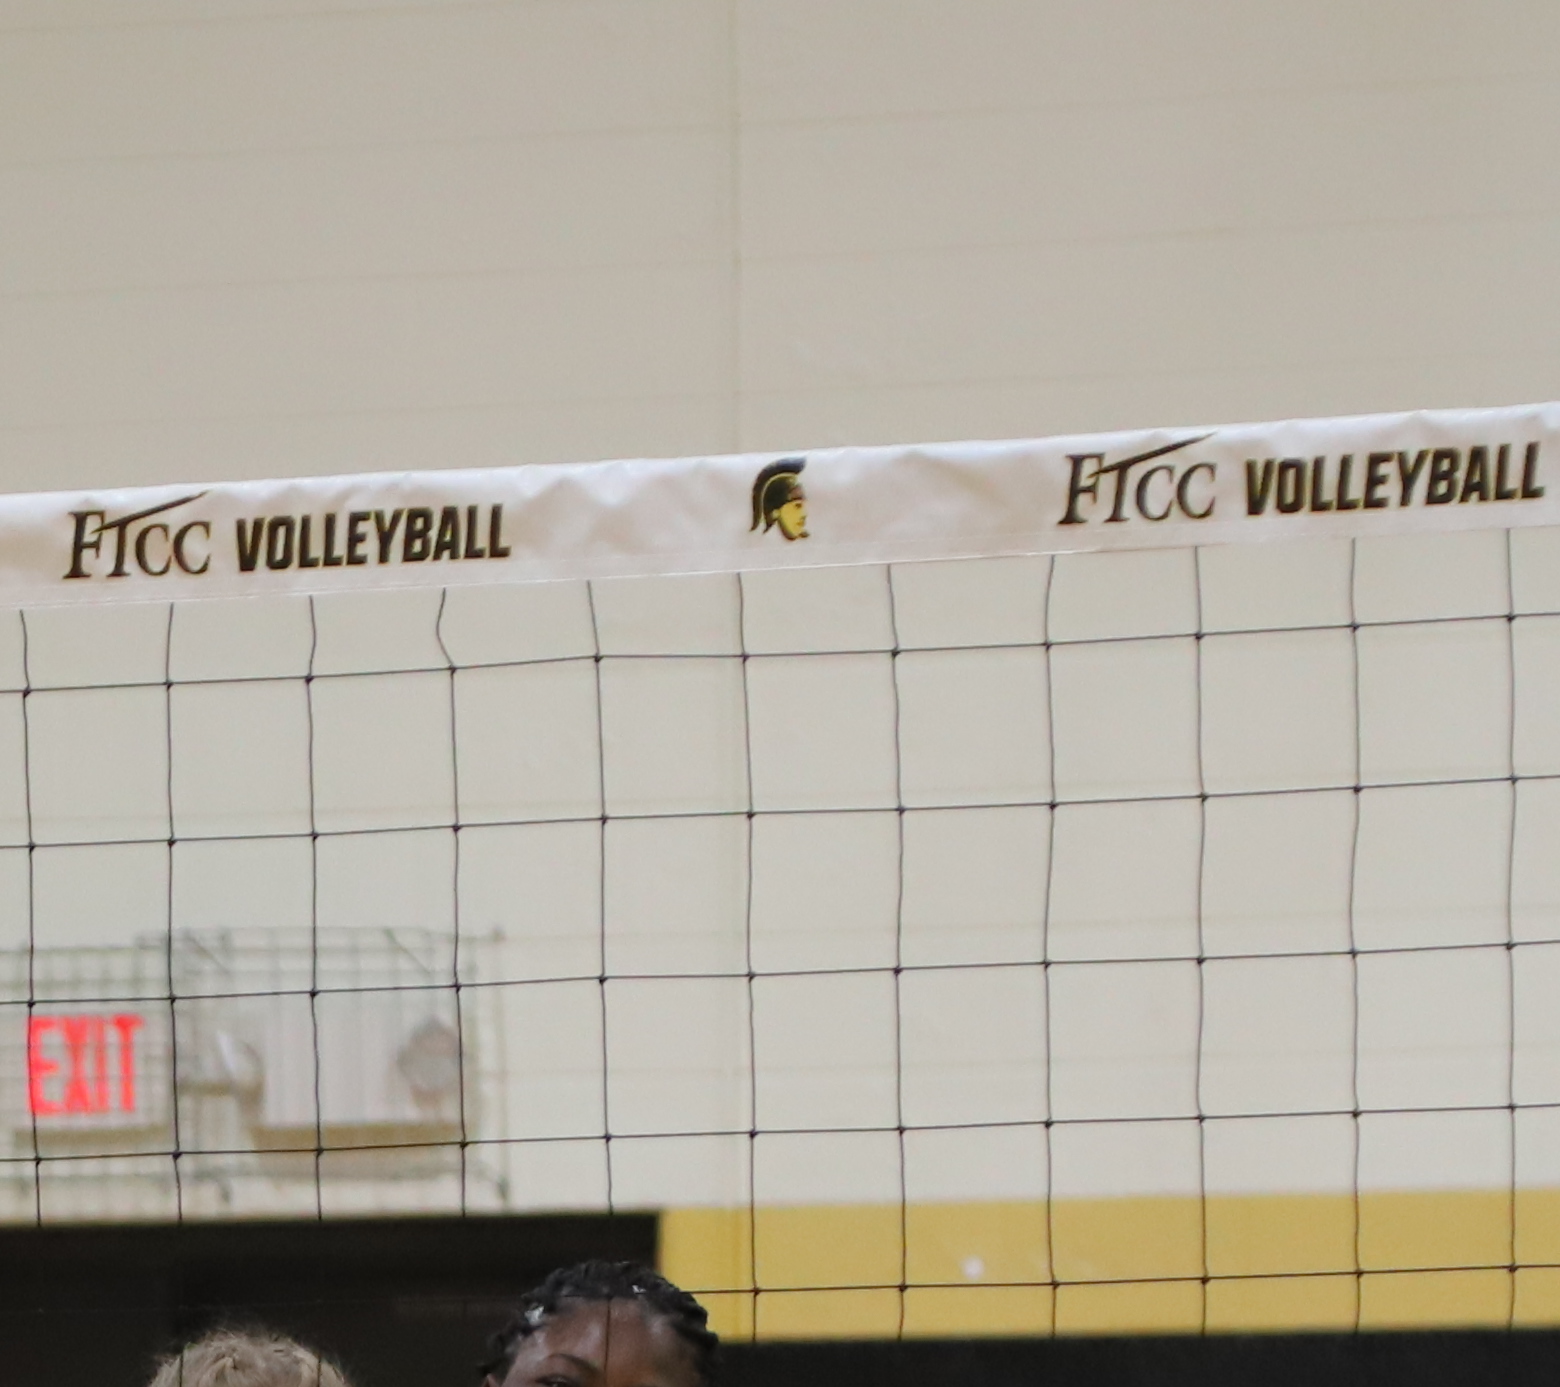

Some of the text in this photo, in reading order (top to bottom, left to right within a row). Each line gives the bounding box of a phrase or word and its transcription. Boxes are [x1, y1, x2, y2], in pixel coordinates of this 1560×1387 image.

[1057, 433, 1545, 526] FTCC VOLLEYBALL
[63, 491, 511, 580] FTCC VOLLEYBALL
[27, 1015, 142, 1116] EXIT
